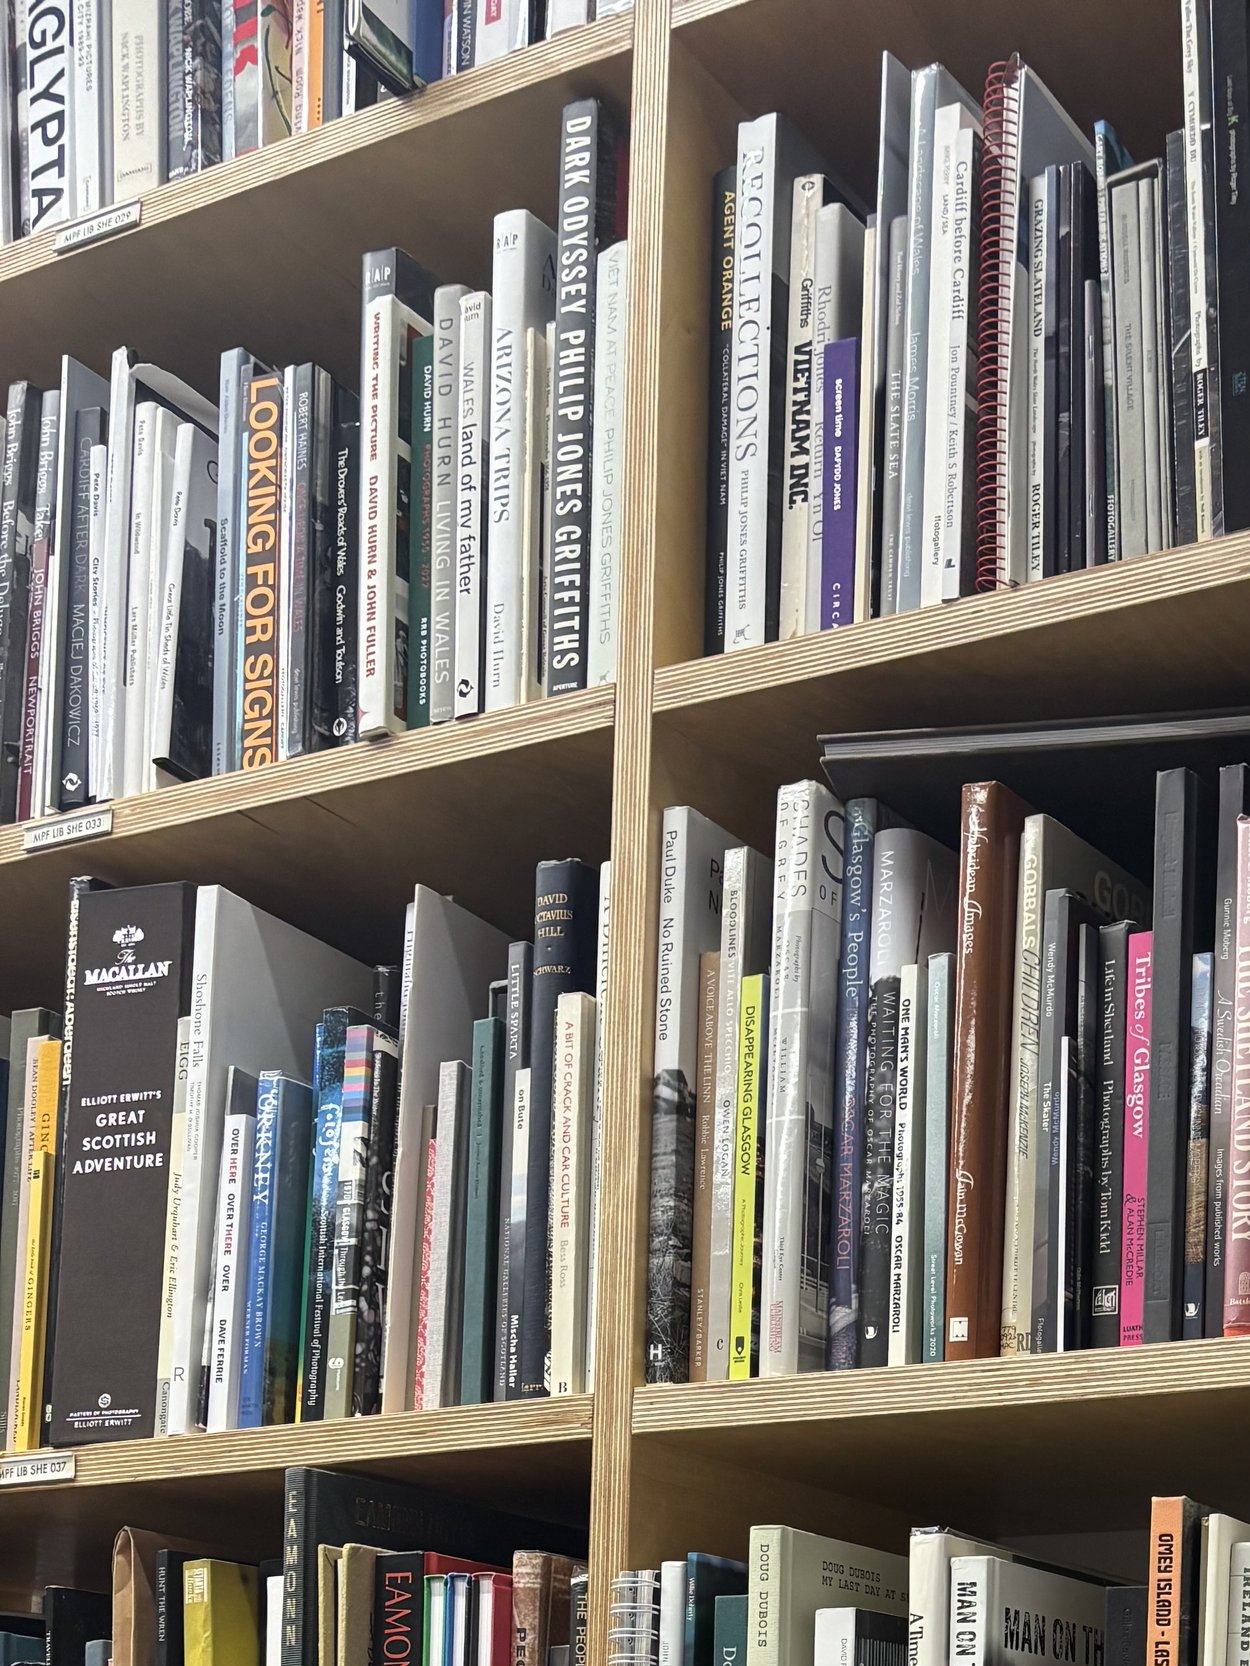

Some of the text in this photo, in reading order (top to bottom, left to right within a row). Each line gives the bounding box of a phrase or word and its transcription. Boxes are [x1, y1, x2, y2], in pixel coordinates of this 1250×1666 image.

[64, 231, 80, 243] MPF
[83, 224, 94, 237] LIB
[97, 217, 112, 231] SHE
[492, 326, 514, 524] ARIZONA TRIPS
[552, 116, 592, 669] DARK ODYSSEY PHILIP JONES GRIFFITHS
[787, 340, 813, 510] VIETNAM INC.
[433, 318, 453, 684] DAVID HURN LIVING IN WALES
[242, 378, 277, 770] LOOKING FOR SIGNS
[33, 817, 102, 843] MPF LIB SHE 033
[659, 830, 678, 1041] Paul Duke No Ruined Stone
[740, 1006, 756, 1176] DISAPPEARING GLASGOW
[1128, 951, 1152, 1139] Tribes of Glasgow
[71, 1153, 165, 1175] ADVENTURE
[80, 1132, 157, 1150] SCOTTISH
[94, 1113, 147, 1128] GREAT
[16, 1461, 67, 1477] LIB SHE 037
[952, 1630, 976, 1657] ON
[953, 1581, 977, 1625] MAN
